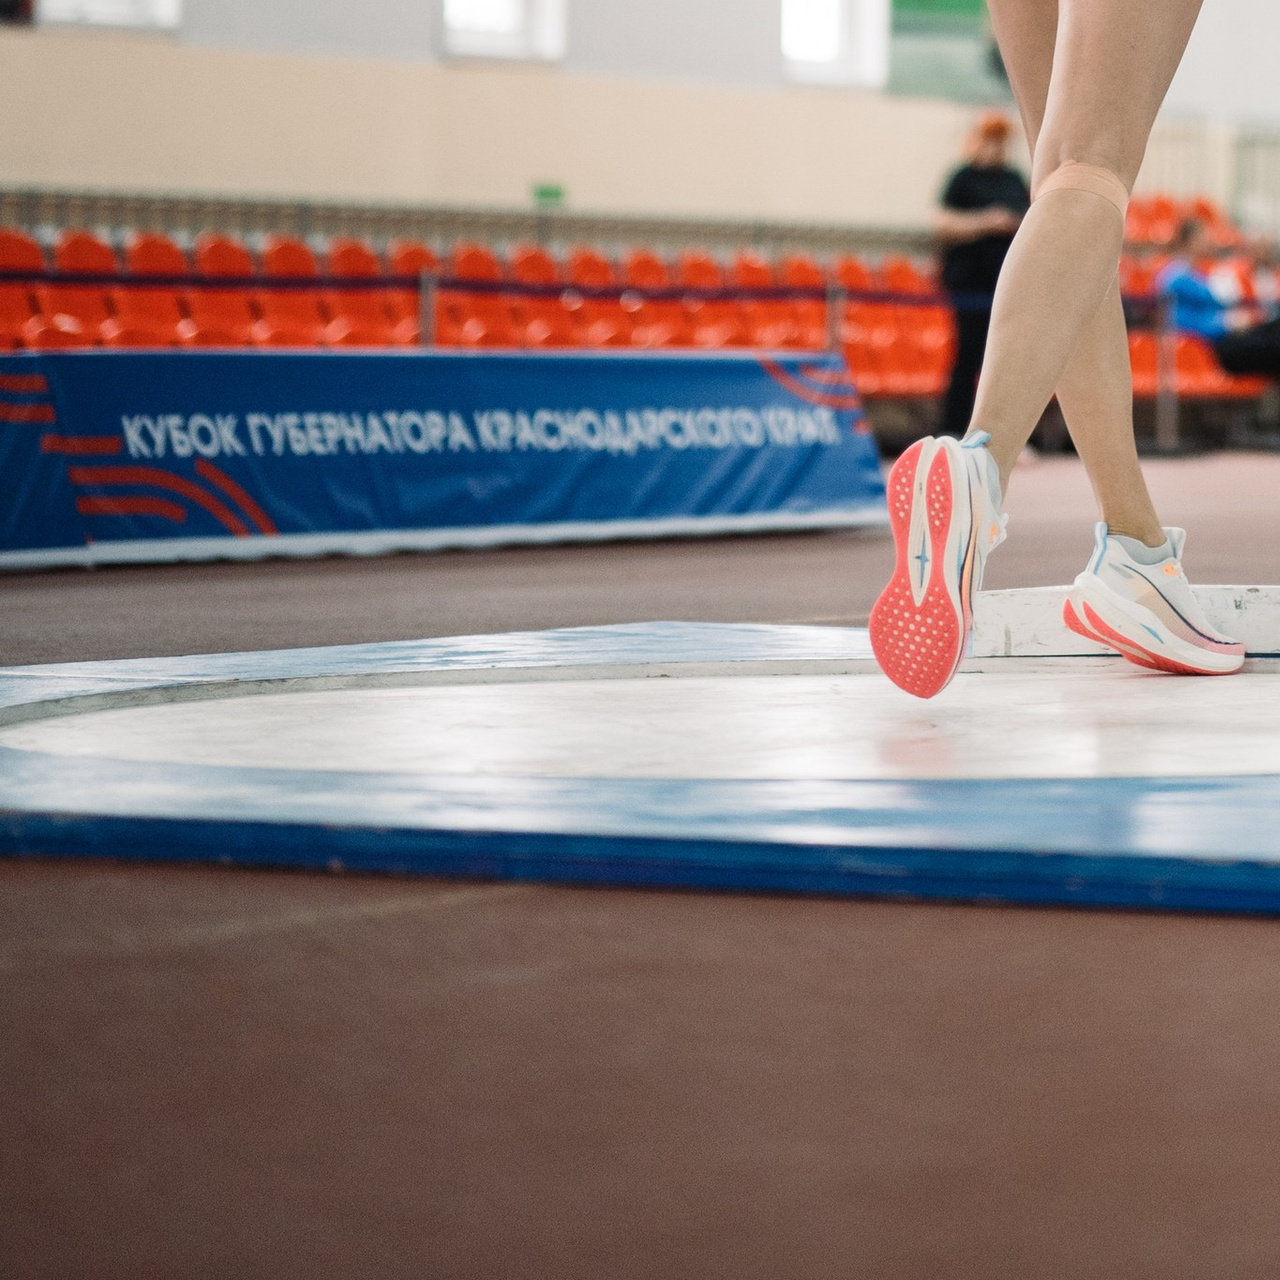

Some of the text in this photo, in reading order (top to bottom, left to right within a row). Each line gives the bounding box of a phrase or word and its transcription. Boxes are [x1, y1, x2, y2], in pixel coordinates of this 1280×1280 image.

[122, 413, 248, 458] КУБОК
[247, 410, 473, 457] ГУБЕРНАТОРА
[474, 408, 763, 455] КРАСНОДАРСКОГО
